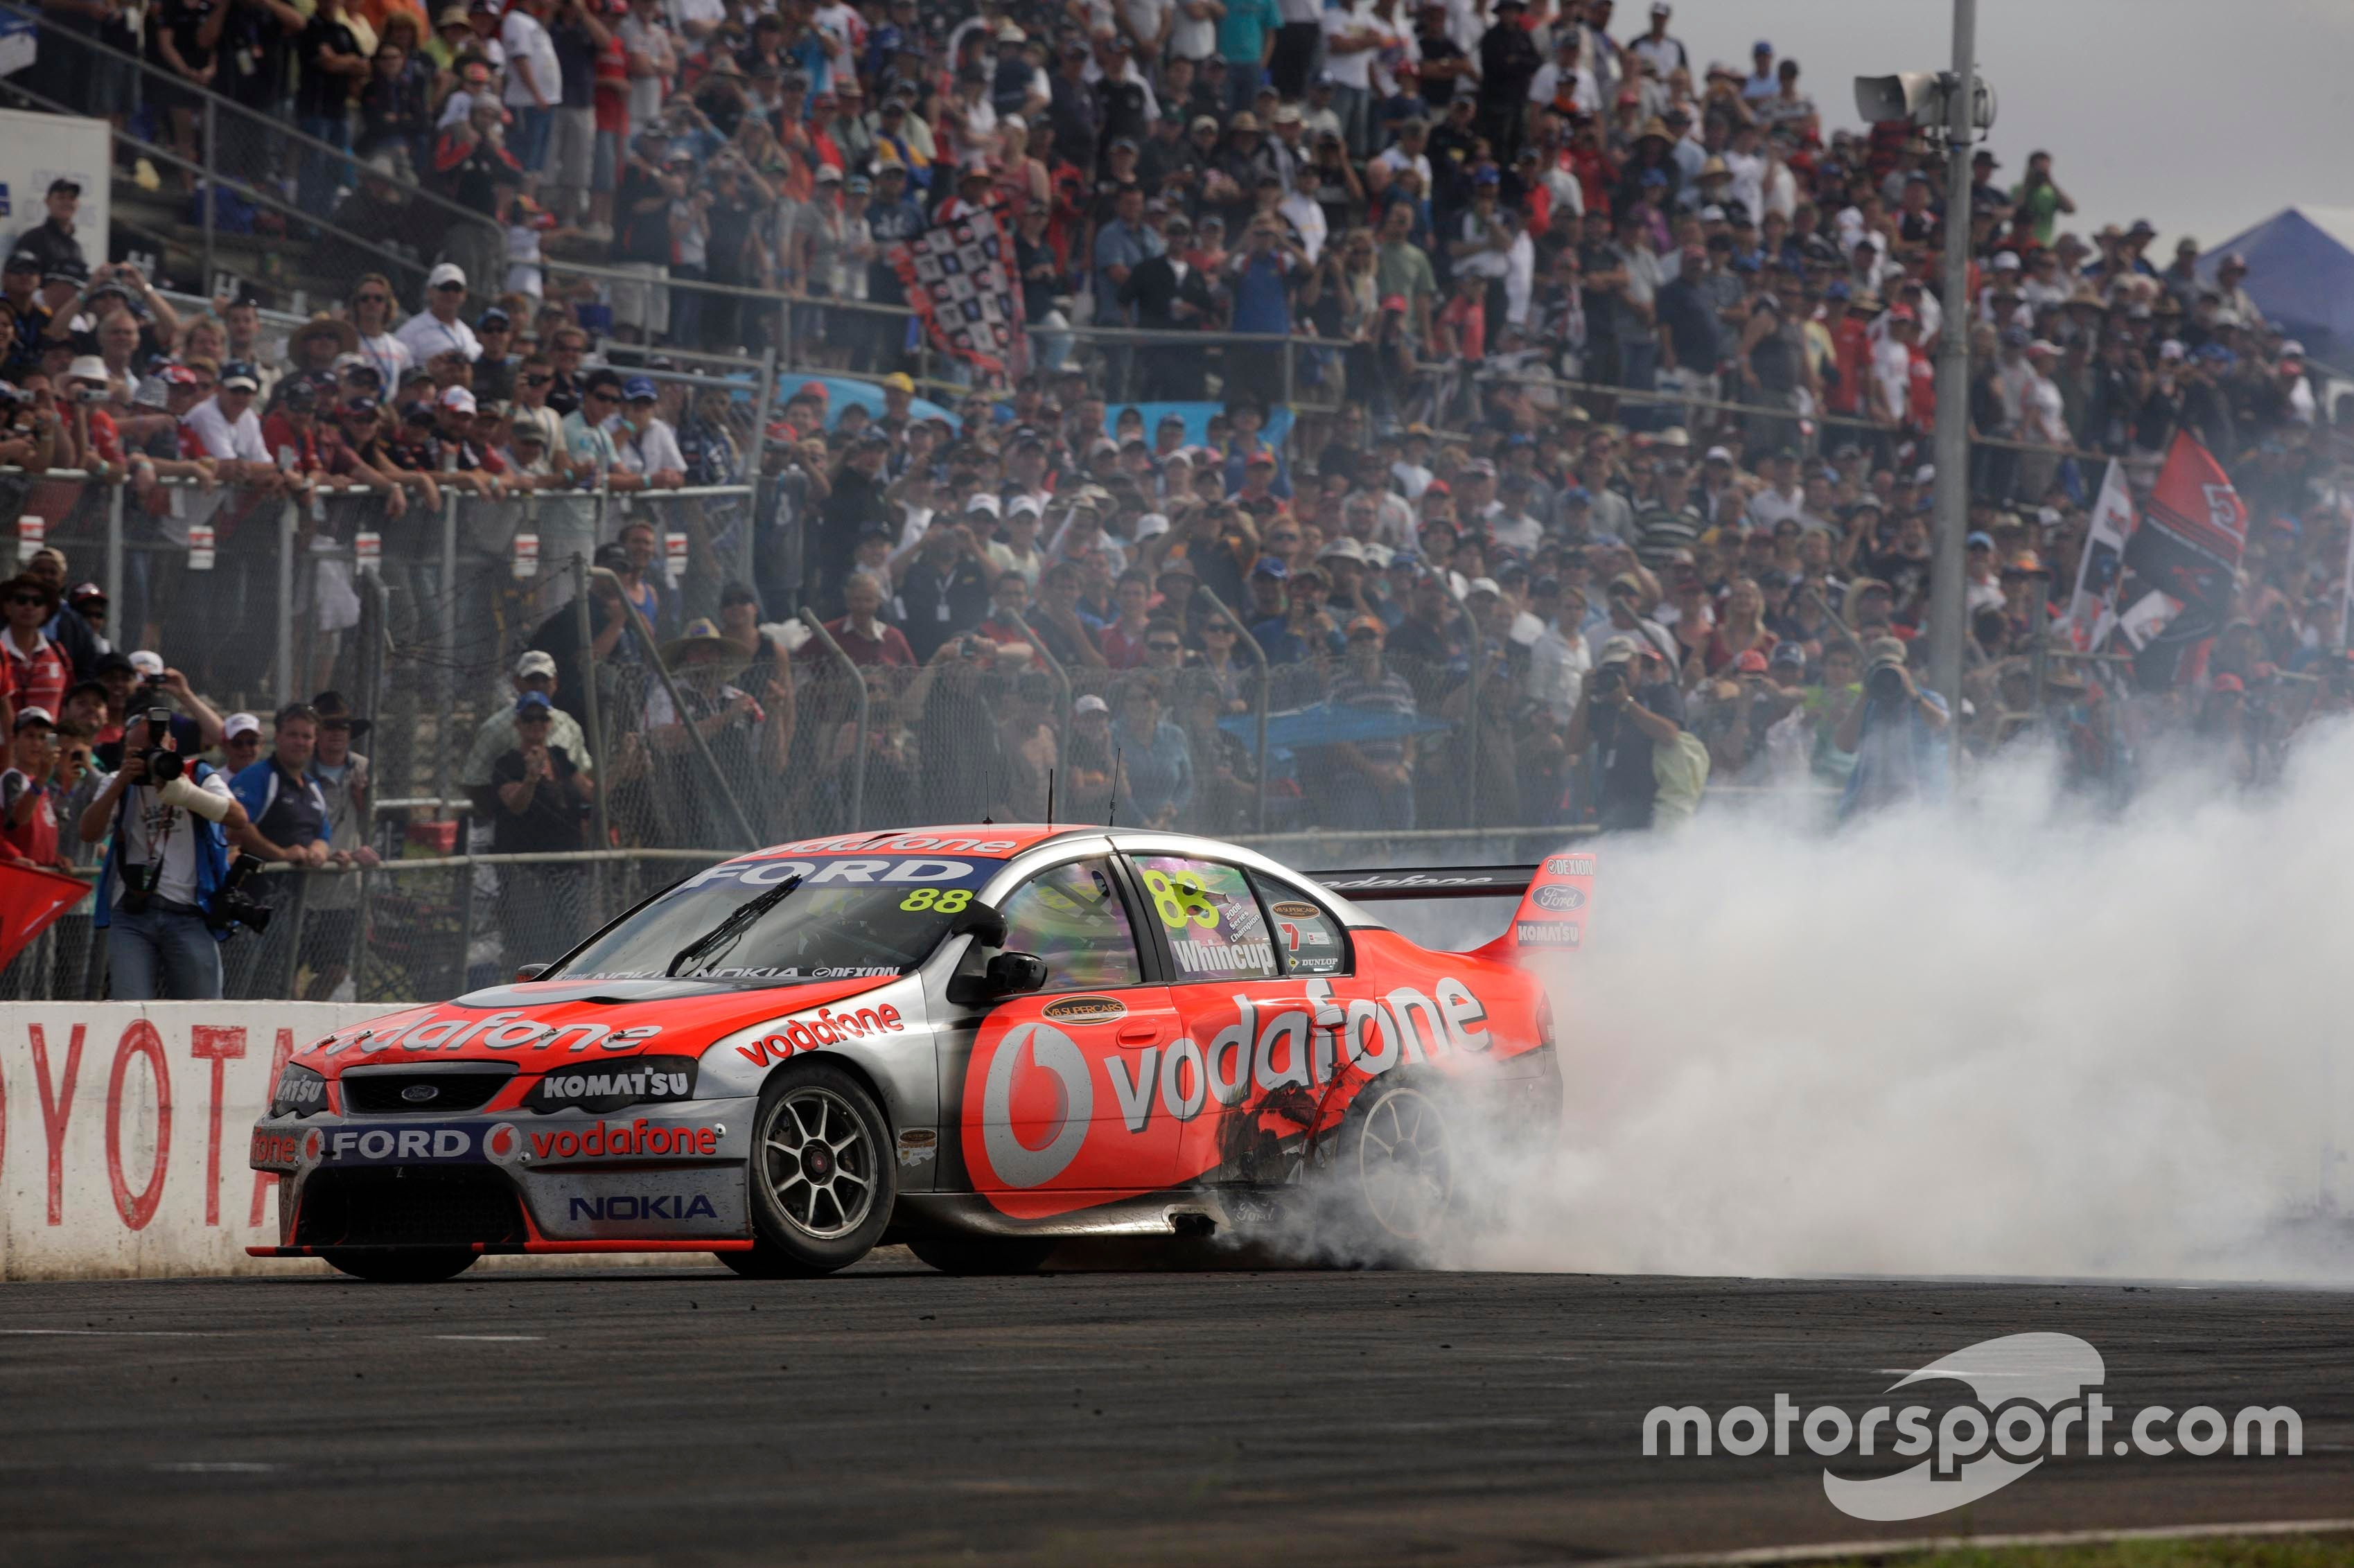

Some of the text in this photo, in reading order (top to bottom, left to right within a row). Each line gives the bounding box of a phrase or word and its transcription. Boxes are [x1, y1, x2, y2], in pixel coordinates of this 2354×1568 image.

[683, 859, 974, 888] FORD
[1556, 859, 1593, 876] DEXION
[1315, 874, 1493, 888] odafone
[899, 888, 974, 914] 88
[1540, 886, 1578, 908] Ford
[1224, 902, 1242, 920] 2008
[1229, 909, 1249, 931] Series
[1230, 913, 1261, 943] Champion
[1518, 922, 1579, 942] KOMATSU
[1173, 939, 1274, 976] Whincup
[1301, 958, 1338, 967] DUNLOP
[1044, 1007, 1062, 1016] V8
[1062, 1003, 1125, 1015] SUPERCARS
[735, 1002, 905, 1068] vodafone
[1103, 977, 1494, 1134] vodafone
[543, 1066, 689, 1098] KOMATSU
[0, 1019, 294, 1231] YOT
[331, 1129, 471, 1161] FORD
[529, 1118, 717, 1160] vodafone
[569, 1195, 718, 1221] NOKIA
